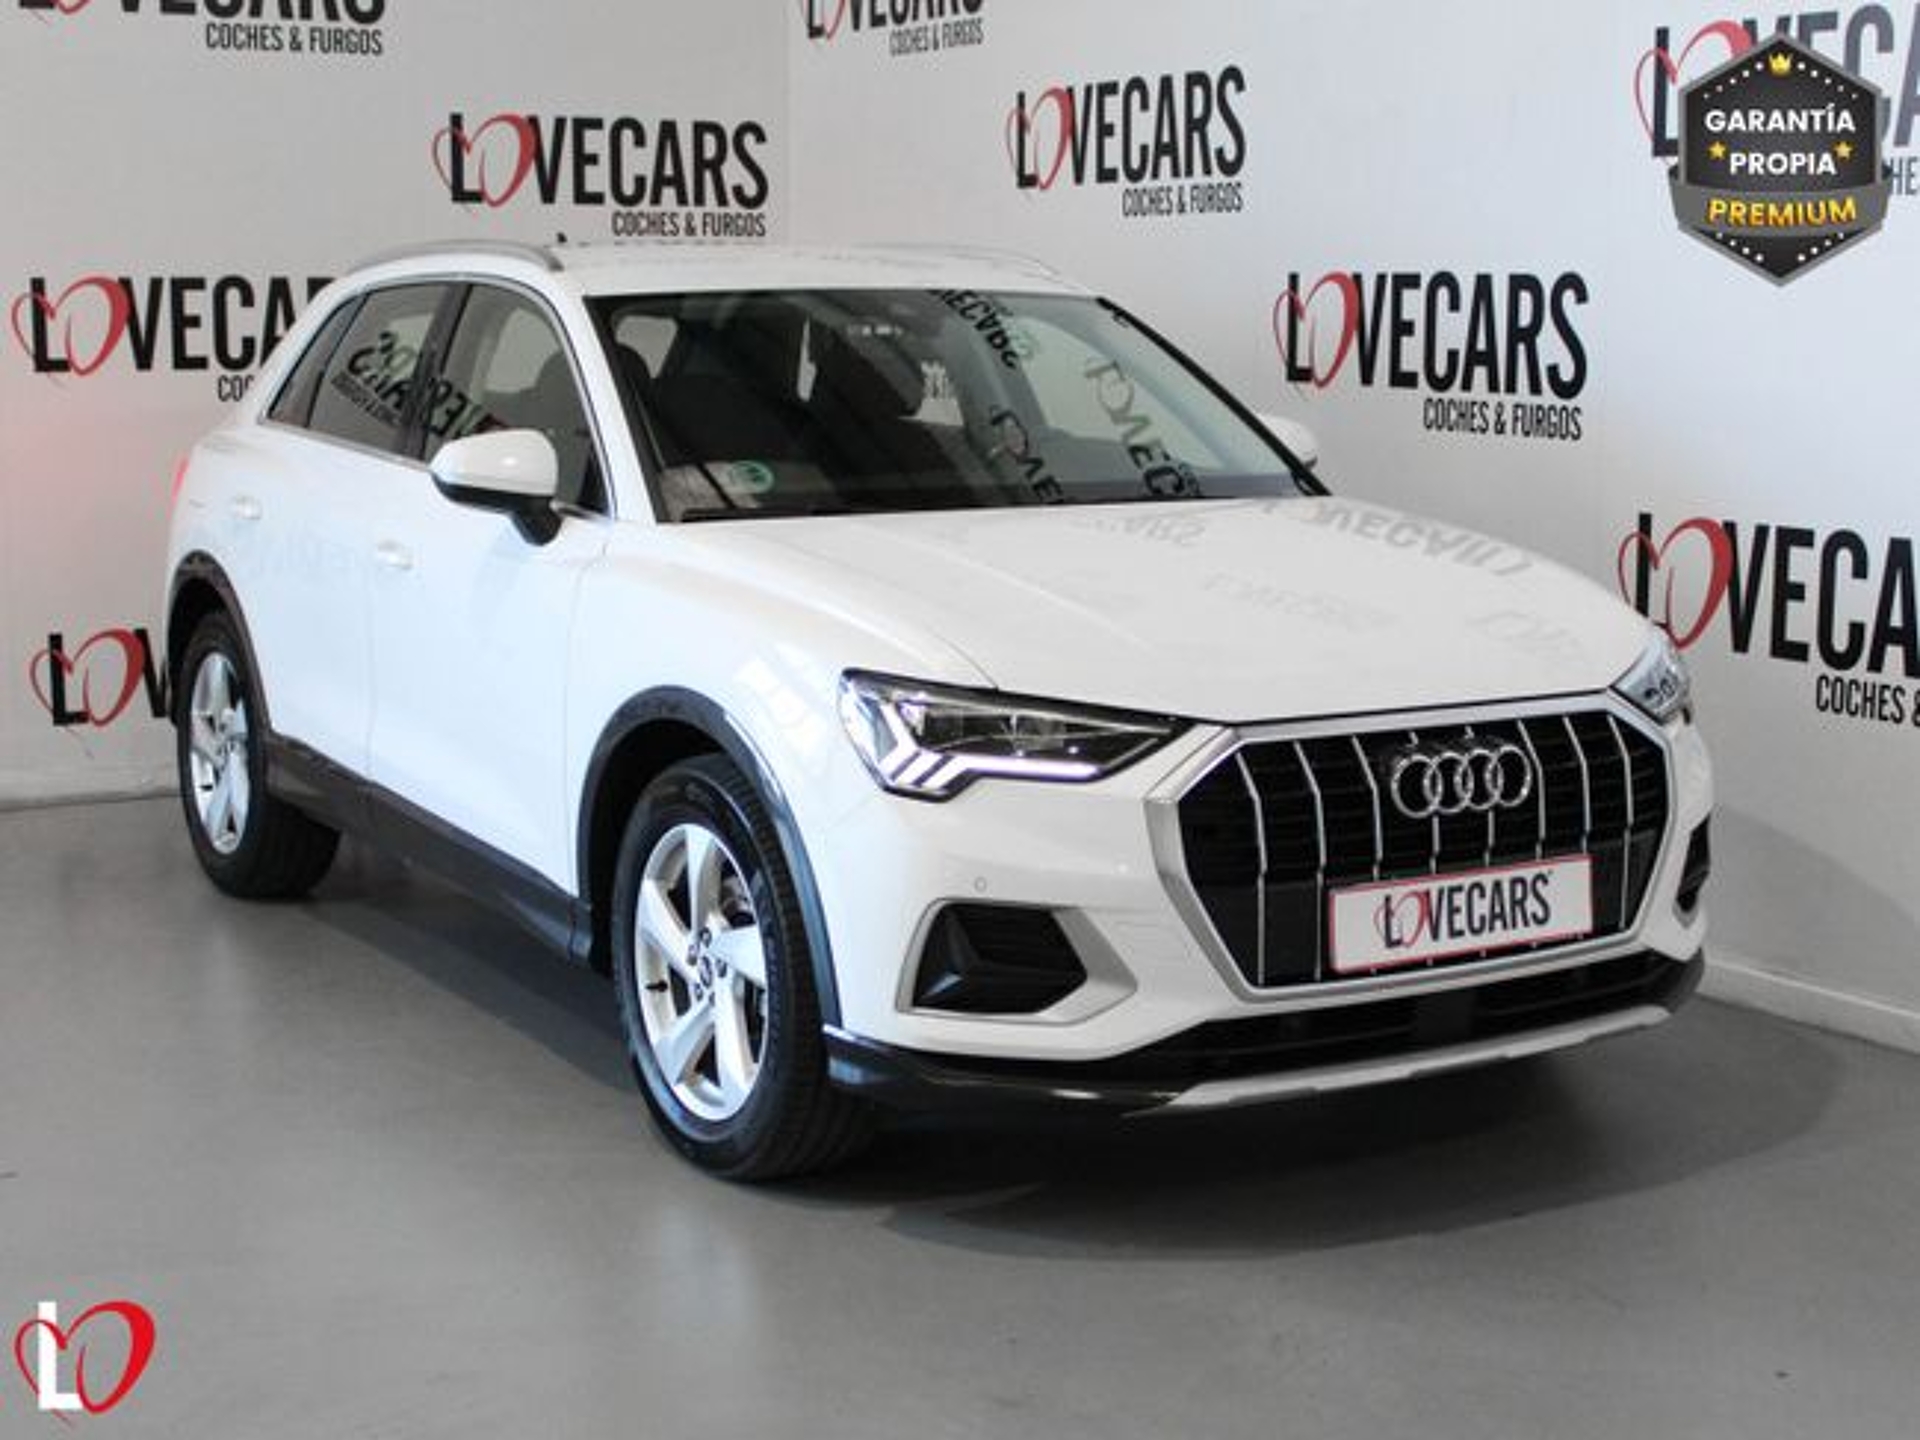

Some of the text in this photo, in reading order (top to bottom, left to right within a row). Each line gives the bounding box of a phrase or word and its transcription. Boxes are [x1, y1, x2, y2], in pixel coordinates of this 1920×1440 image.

[205, 23, 382, 55] COCHES & FURGOS
[1006, 64, 1246, 190] LOVECARS
[433, 112, 769, 209] LOVECARS
[612, 210, 766, 237] COCHES & FURGOS
[1273, 270, 1589, 401] LOVECARS
[1423, 398, 1582, 441] COCHES & FURGOS
[1816, 673, 1906, 725] COCHES
[1374, 872, 1551, 948] LOVECARS
